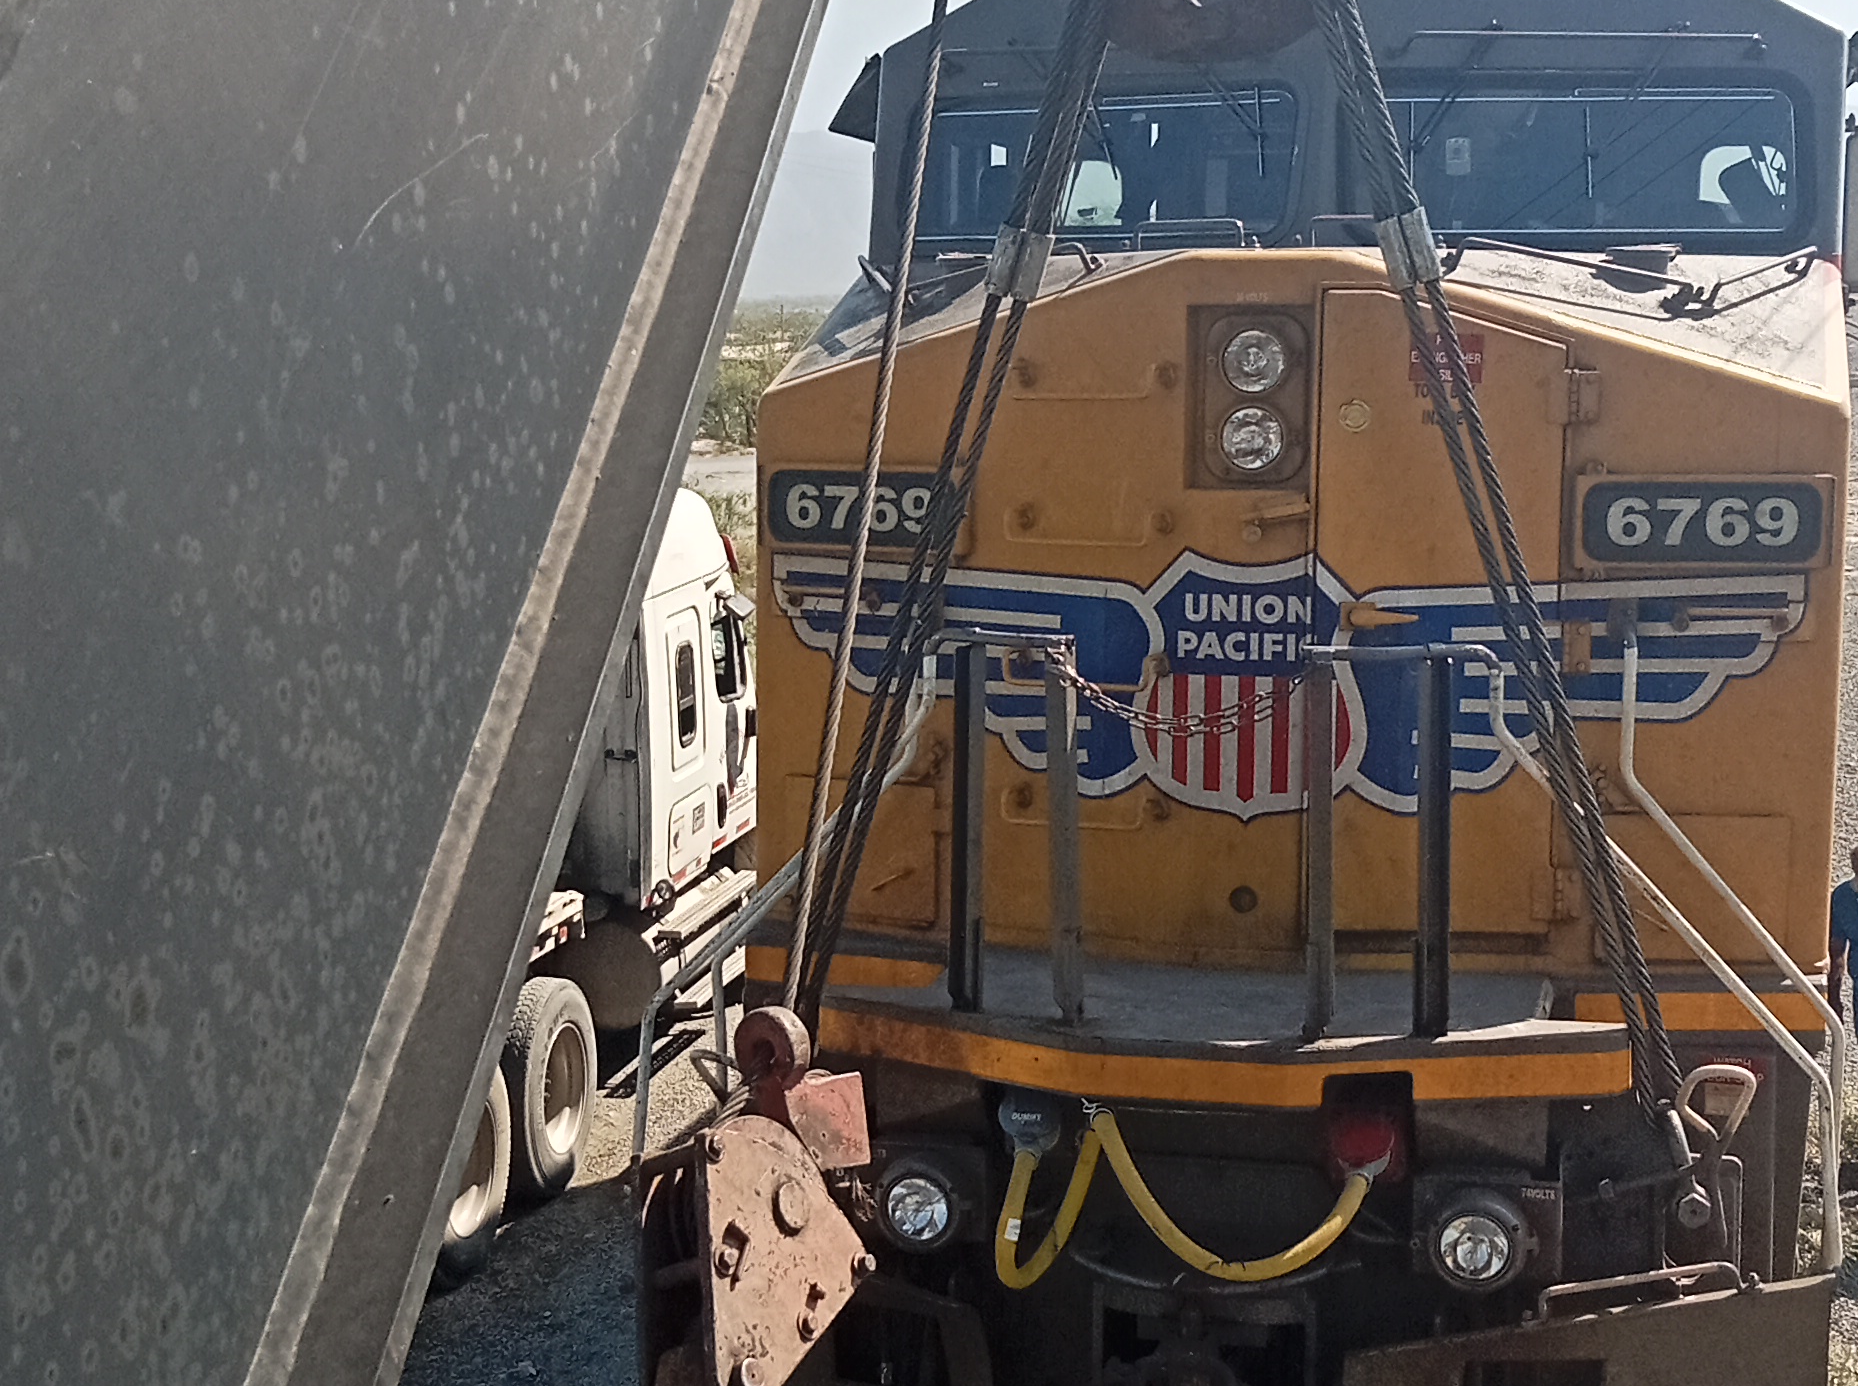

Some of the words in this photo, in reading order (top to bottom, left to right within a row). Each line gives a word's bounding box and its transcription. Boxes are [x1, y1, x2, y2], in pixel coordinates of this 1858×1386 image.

[785, 483, 932, 535] 6769
[1606, 496, 1800, 547] 6769
[1184, 592, 1313, 625] UNION
